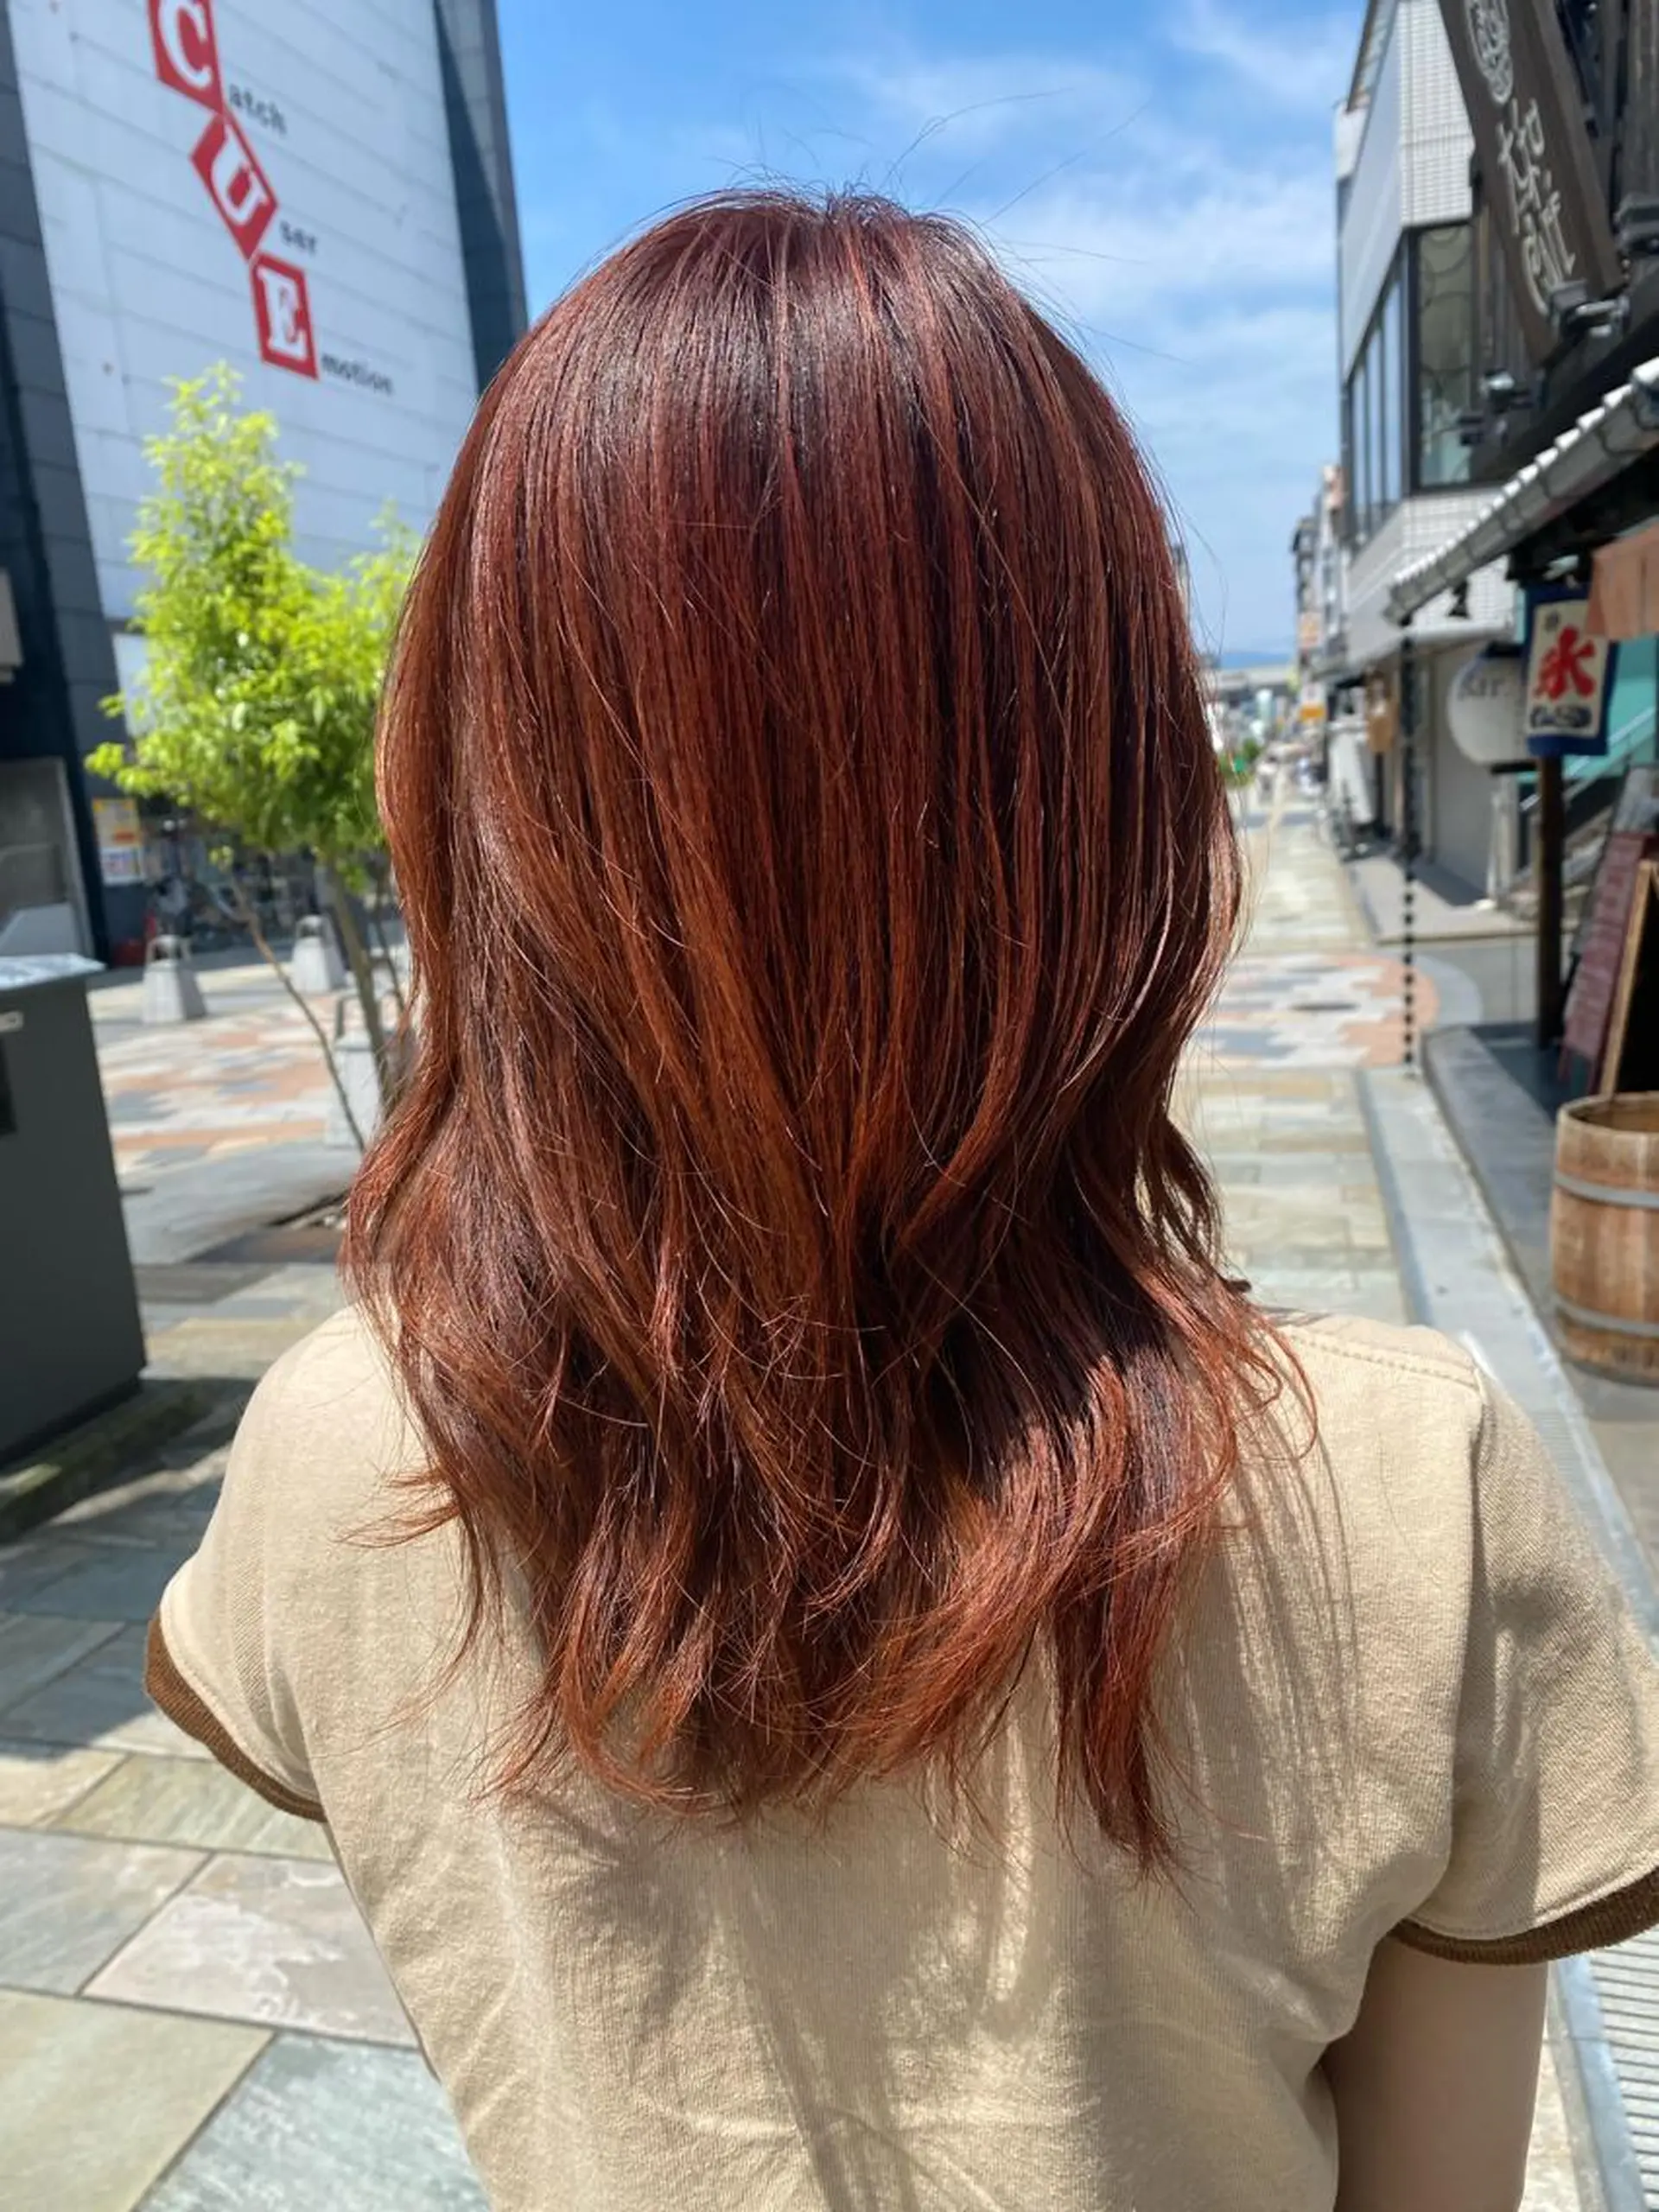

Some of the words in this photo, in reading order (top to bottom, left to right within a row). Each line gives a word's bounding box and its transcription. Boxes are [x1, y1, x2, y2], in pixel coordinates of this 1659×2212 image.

[158, 0, 213, 90] C
[210, 124, 269, 227] U
[257, 266, 309, 361] E
[321, 353, 393, 394] motion
[1533, 624, 1596, 702] 氷
